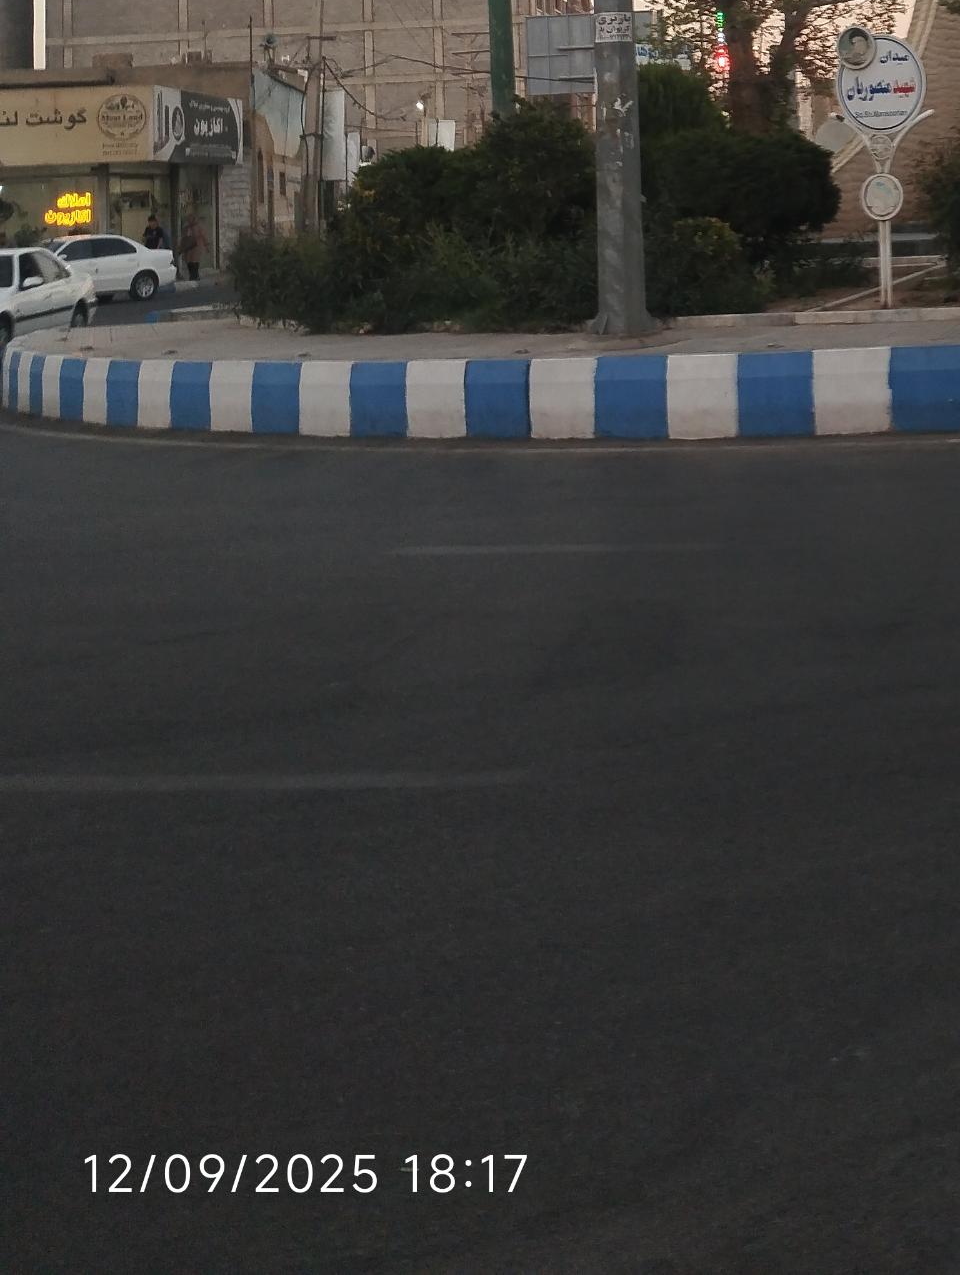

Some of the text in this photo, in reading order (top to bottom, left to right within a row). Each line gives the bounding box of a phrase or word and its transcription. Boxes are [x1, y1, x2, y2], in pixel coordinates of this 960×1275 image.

[880, 50, 909, 64] میدان
[893, 75, 917, 97] شهید
[0, 108, 87, 130] گوشت لن
[57, 192, 91, 208] املاک
[44, 209, 91, 226] اکازیون
